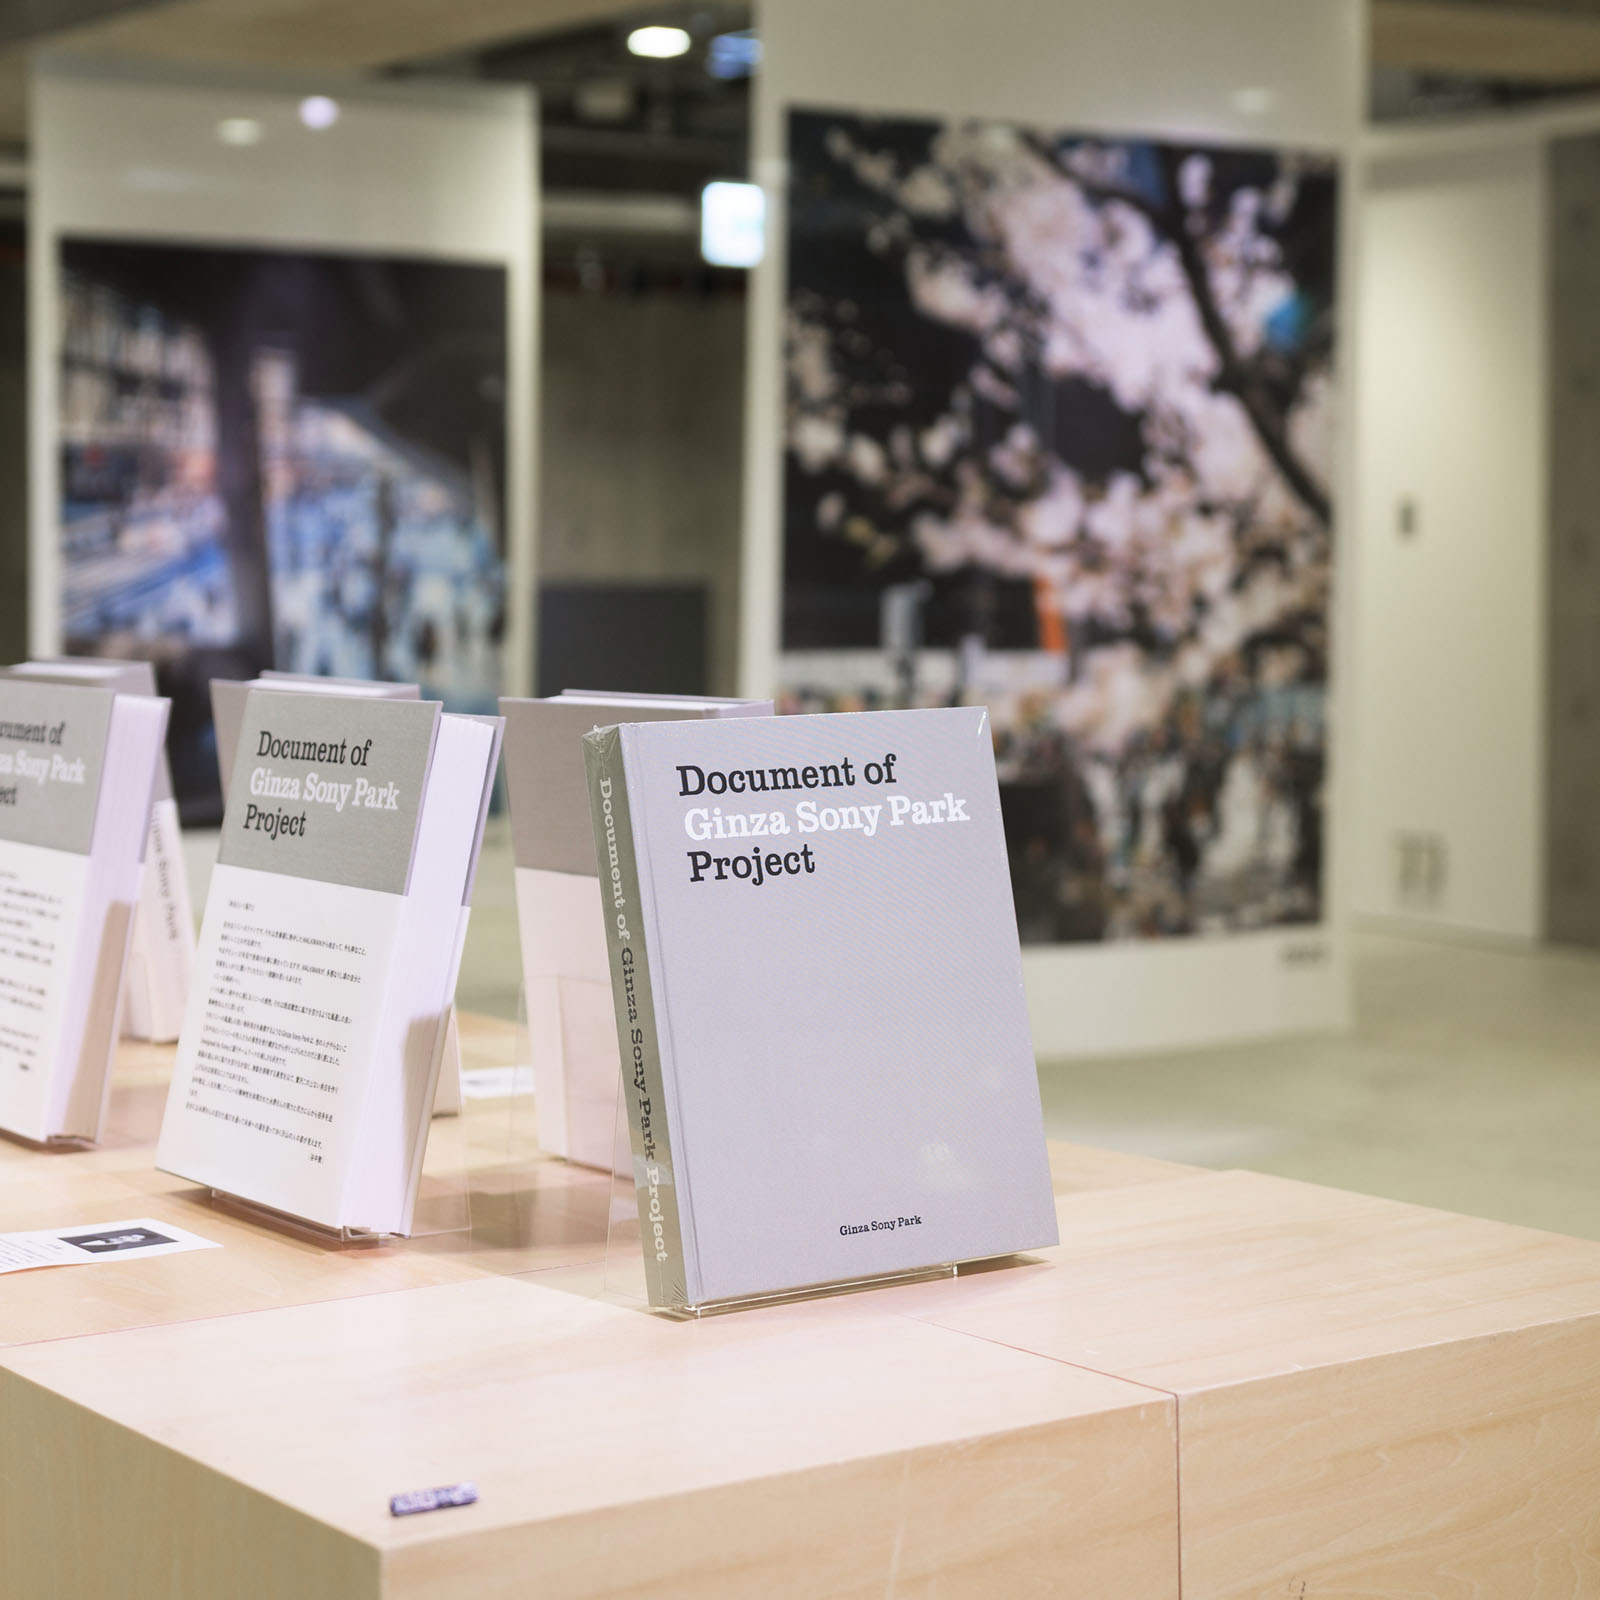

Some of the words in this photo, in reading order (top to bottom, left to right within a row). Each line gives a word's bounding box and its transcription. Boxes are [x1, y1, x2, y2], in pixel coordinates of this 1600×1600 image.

[49, 721, 66, 745] of
[256, 730, 347, 765] Document
[350, 738, 373, 766] of
[50, 753, 86, 785] Park
[249, 767, 301, 800] Ginza
[302, 772, 352, 812] Sony
[352, 777, 400, 810] Park
[676, 757, 856, 796] Document
[864, 753, 898, 785] of
[243, 803, 306, 840] Project
[684, 808, 790, 841] Ginza
[796, 801, 882, 837] Sony
[886, 793, 971, 826] Park
[600, 777, 626, 908] Document
[687, 844, 815, 886] Project
[616, 913, 631, 940] of
[621, 947, 638, 1023] Ginza
[631, 1028, 647, 1093] Sony
[639, 1098, 656, 1161] Park
[646, 1166, 669, 1262] Project
[839, 1224, 870, 1236] Ginza
[871, 1220, 896, 1231] Sony
[897, 1215, 922, 1228] Park
